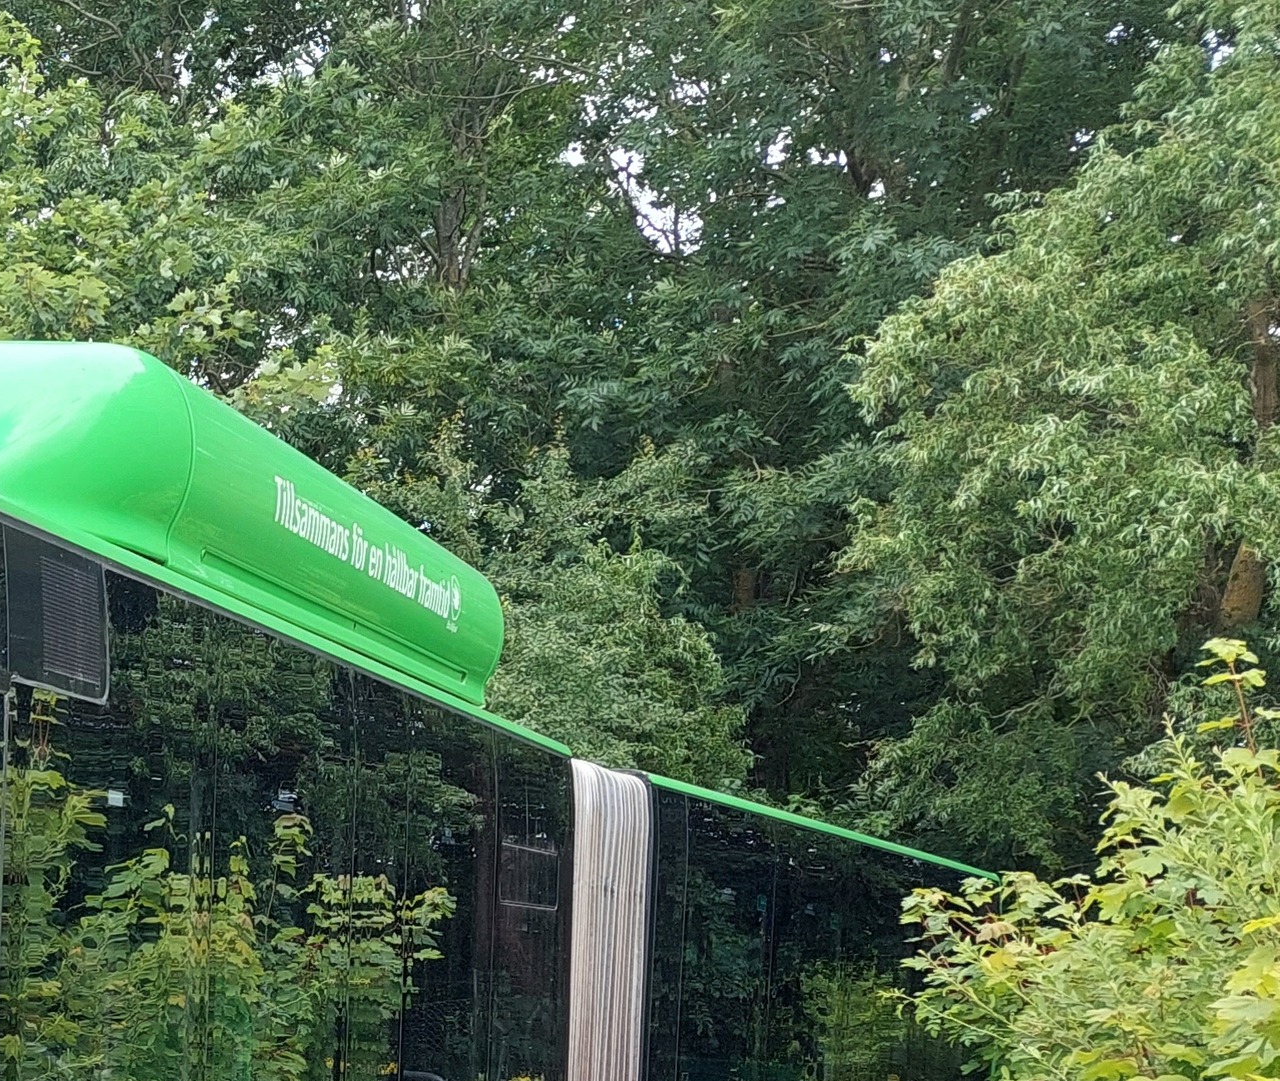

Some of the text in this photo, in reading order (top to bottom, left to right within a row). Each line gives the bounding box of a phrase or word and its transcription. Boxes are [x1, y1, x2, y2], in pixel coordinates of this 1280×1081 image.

[274, 475, 450, 618] Tillsammans för en hållbar framtid
